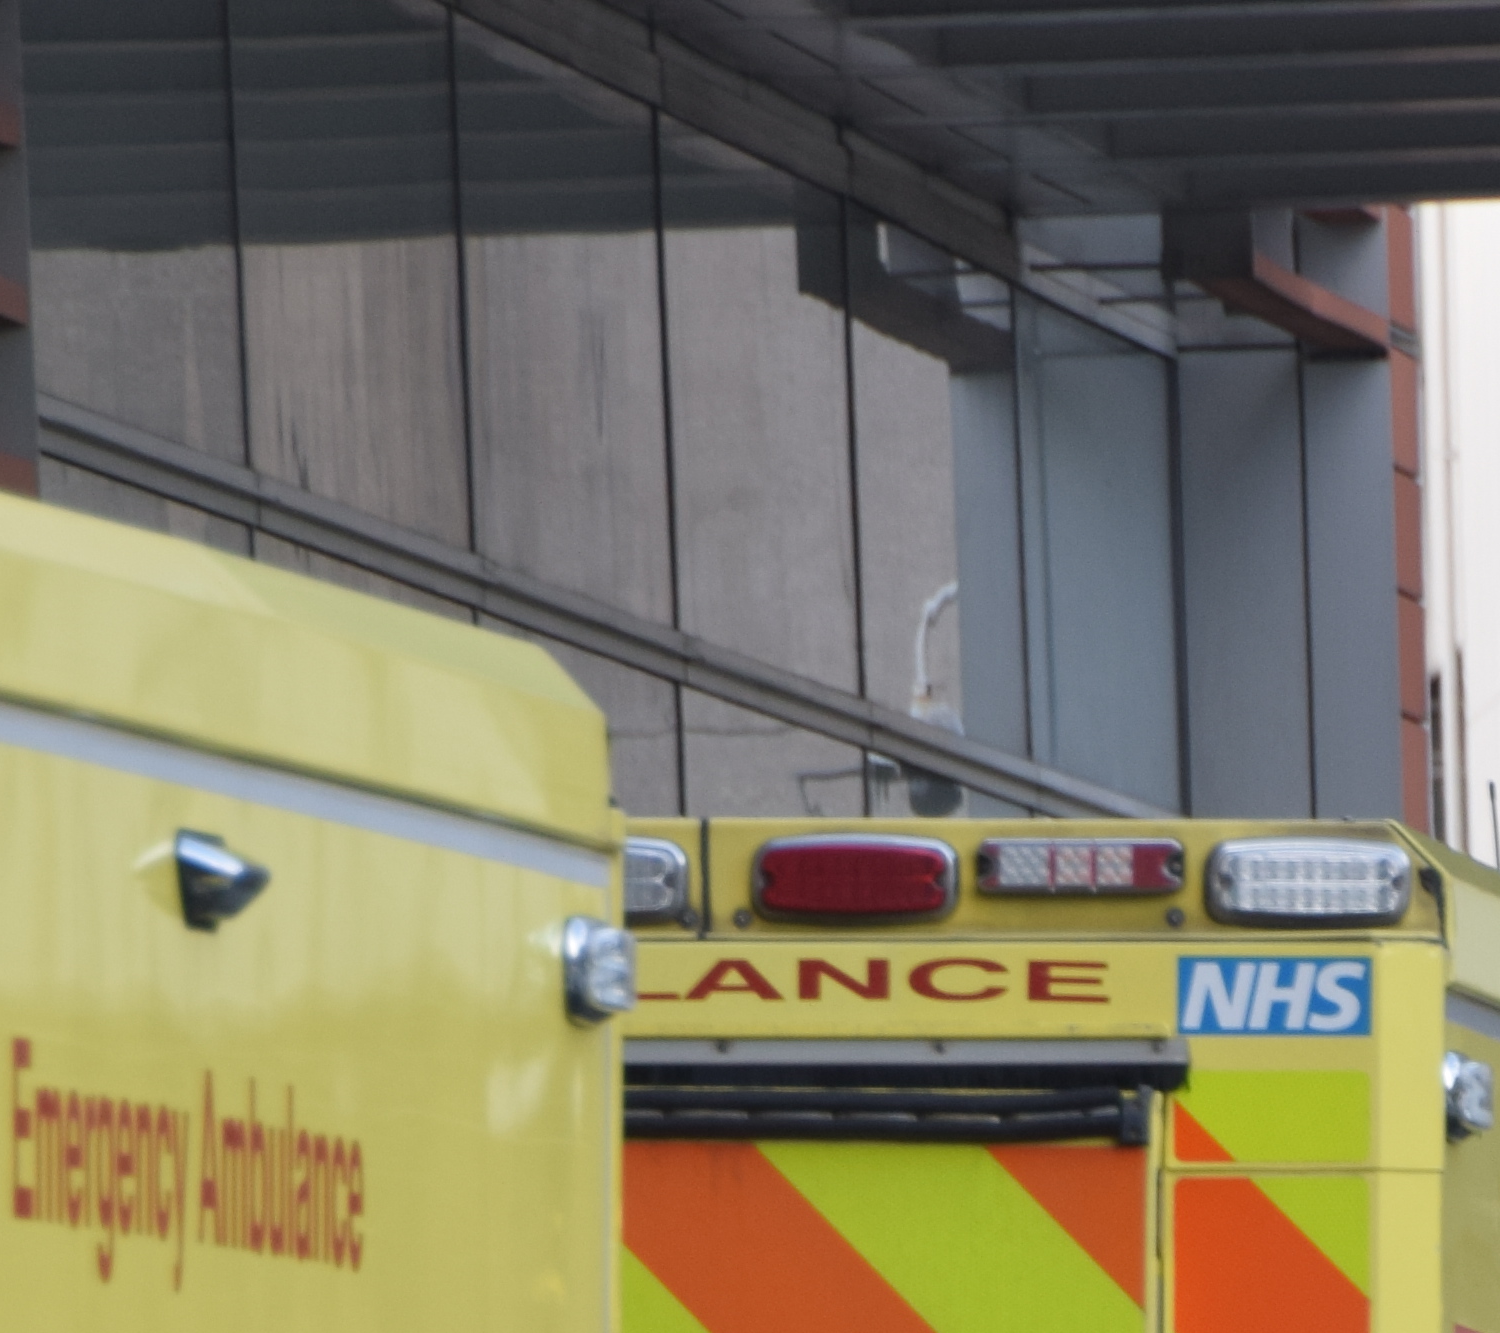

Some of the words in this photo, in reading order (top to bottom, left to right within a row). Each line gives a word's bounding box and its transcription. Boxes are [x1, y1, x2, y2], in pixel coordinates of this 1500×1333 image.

[636, 957, 1111, 1004] ANCE
[1181, 960, 1368, 1032] NHS
[12, 1036, 190, 1293] Emergency
[197, 1066, 364, 1271] Ambulance
